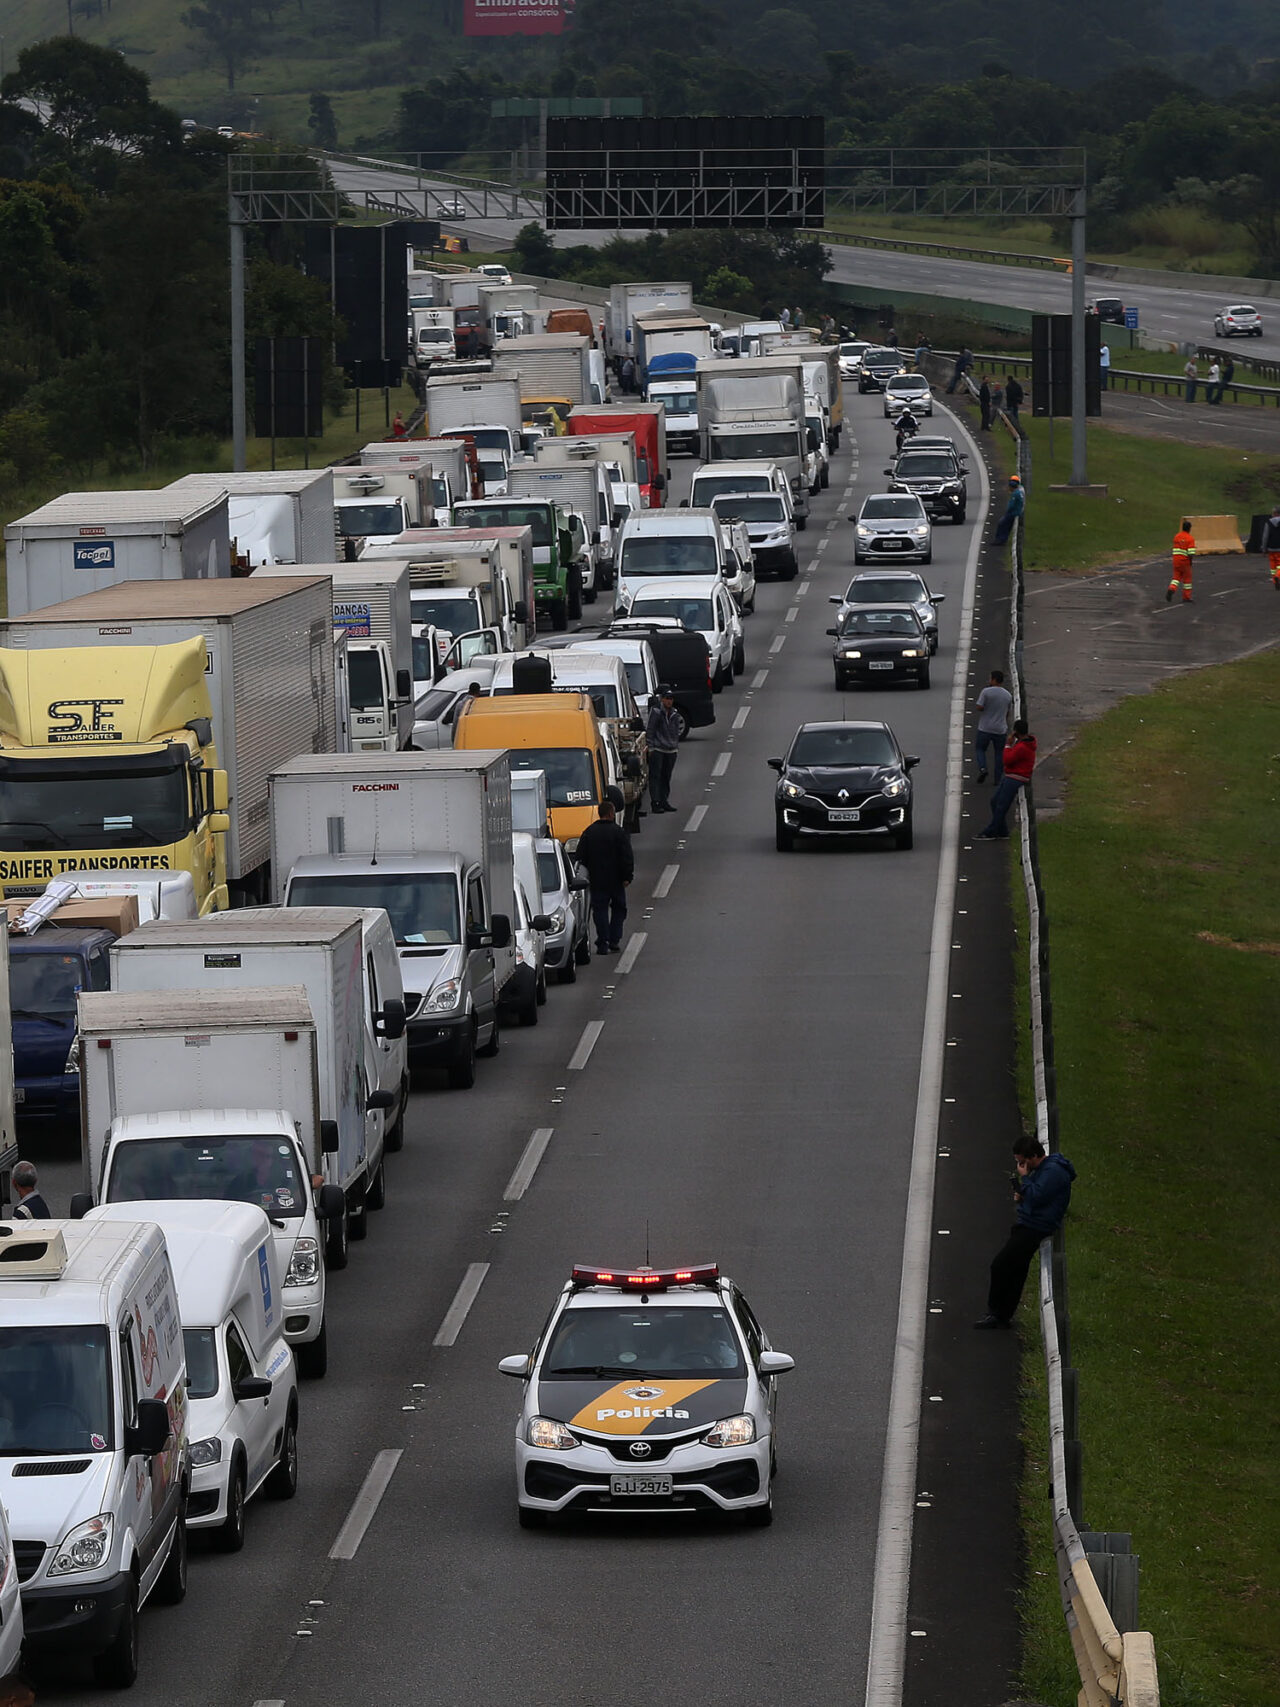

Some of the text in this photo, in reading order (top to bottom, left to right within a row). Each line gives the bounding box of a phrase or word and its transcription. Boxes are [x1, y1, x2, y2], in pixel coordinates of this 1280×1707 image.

[518, 8, 559, 16] consórcio
[76, 549, 109, 564] Tecpel
[334, 604, 368, 617] DANÇAS
[56, 733, 115, 741] TRANSPORTES
[352, 783, 400, 792] FACCHINI
[566, 790, 592, 801] DEUS
[0, 855, 169, 880] SAIFER TRANSPORTES
[596, 1406, 690, 1421] Polícia
[613, 1482, 670, 1493] GJJ-2975
